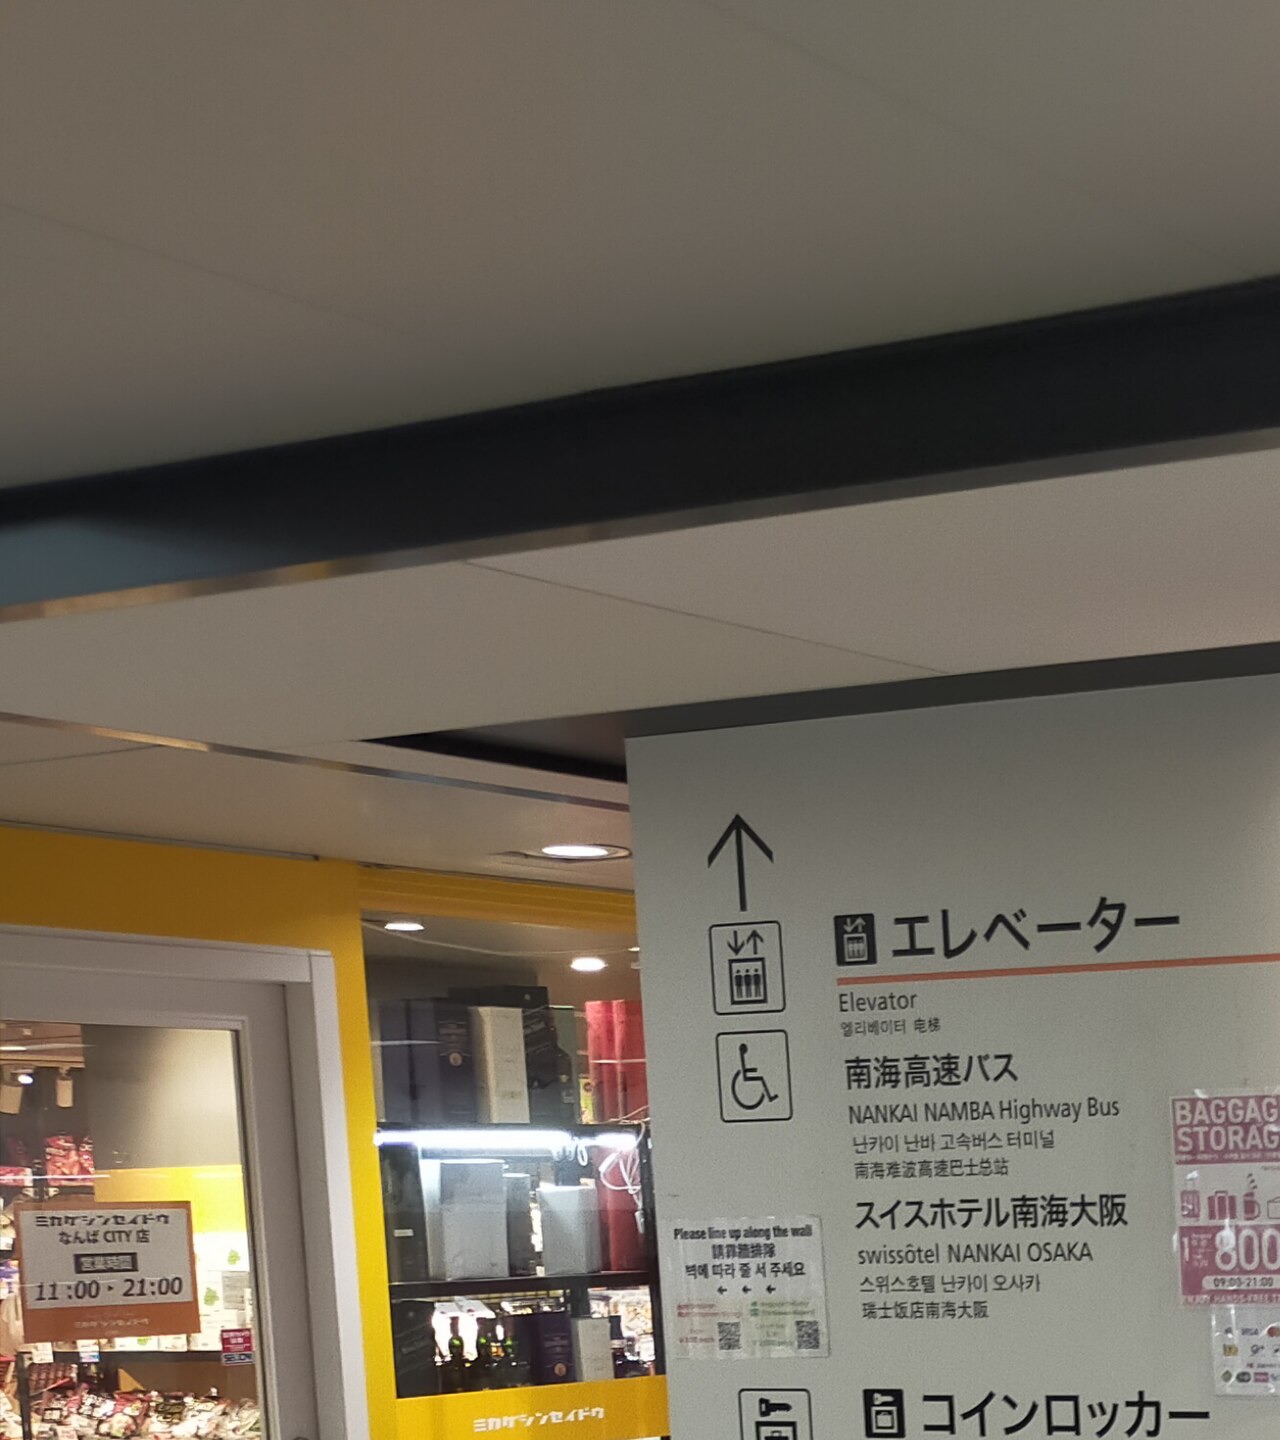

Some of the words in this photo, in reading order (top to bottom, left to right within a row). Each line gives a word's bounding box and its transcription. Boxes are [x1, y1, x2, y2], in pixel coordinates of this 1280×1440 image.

[891, 897, 1180, 960] エレベーター
[838, 992, 917, 1012] Elevator
[841, 1019, 906, 1037] 엘리베이터
[845, 1053, 1018, 1090] 南海高速バス
[849, 1103, 918, 1124] NANKAI
[924, 1101, 995, 1122] NAMBA
[1000, 1099, 1082, 1125] Highway
[1087, 1097, 1119, 1117] Bus
[853, 1134, 899, 1154] 난카이
[904, 1133, 936, 1152] 난바
[940, 1132, 1003, 1151] 고속버스
[1006, 1130, 1055, 1149] 터미널
[855, 1194, 1128, 1230] スイスホテル南海大阪
[674, 1228, 706, 1240] Please
[729, 1229, 741, 1241] up
[743, 1226, 771, 1240] along
[773, 1225, 788, 1238] the
[791, 1224, 812, 1237] wall
[858, 1243, 940, 1264] swissôtel
[948, 1243, 1021, 1263] NANKAI
[1027, 1242, 1093, 1262] OSAKA
[36, 1280, 100, 1300] 11:00
[122, 1276, 182, 1297] 21:00
[859, 1275, 936, 1294] 스위스호텔
[941, 1274, 988, 1293] 난카이
[993, 1273, 1041, 1292] 오사카
[473, 1406, 605, 1432] ミカゲシンセイドウ
[922, 1390, 1211, 1438] コインロッカー
